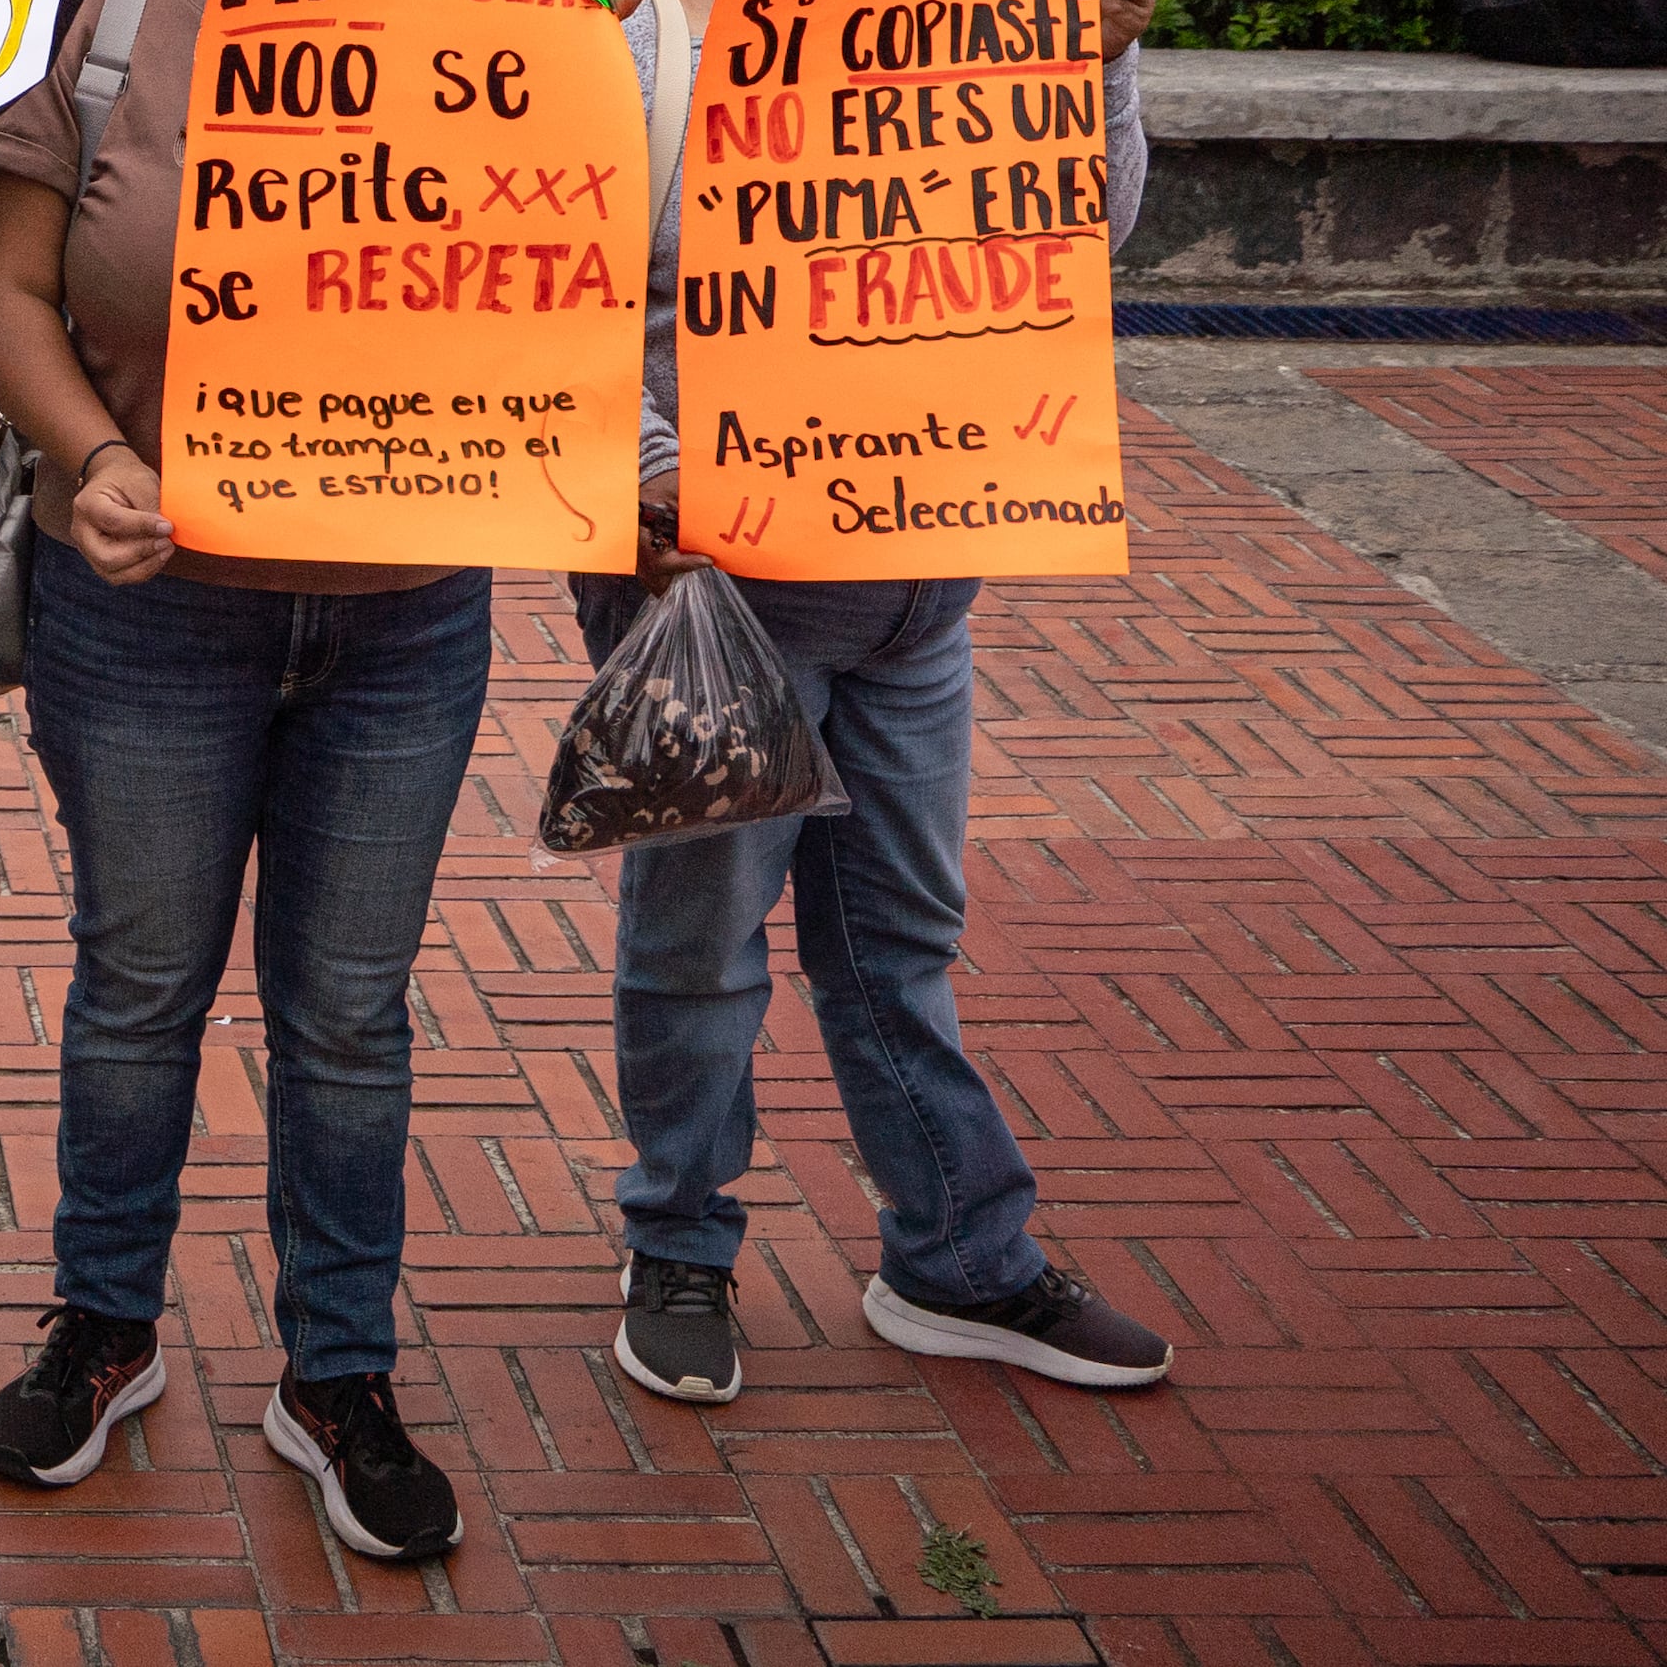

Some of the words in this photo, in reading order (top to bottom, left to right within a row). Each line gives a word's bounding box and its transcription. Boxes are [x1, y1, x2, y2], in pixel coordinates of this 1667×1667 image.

[214, 40, 377, 118] NOO
[704, 90, 806, 165] NO
[831, 82, 994, 158] ERES
[1011, 79, 1096, 141] UN
[969, 154, 1108, 237] ERES
[306, 241, 637, 314] RESPETA.
[683, 264, 777, 338] UN
[807, 239, 1075, 331] FRAUDE
[318, 391, 434, 430] pague
[501, 390, 578, 423] que
[715, 410, 988, 479] Aspirante
[185, 432, 273, 461] hizo
[280, 432, 450, 475] trampa,
[460, 437, 506, 460] no
[524, 435, 562, 458] el
[216, 478, 298, 514] que
[318, 469, 500, 500] ESTUDIO!
[826, 476, 1126, 536] Seleccionado
